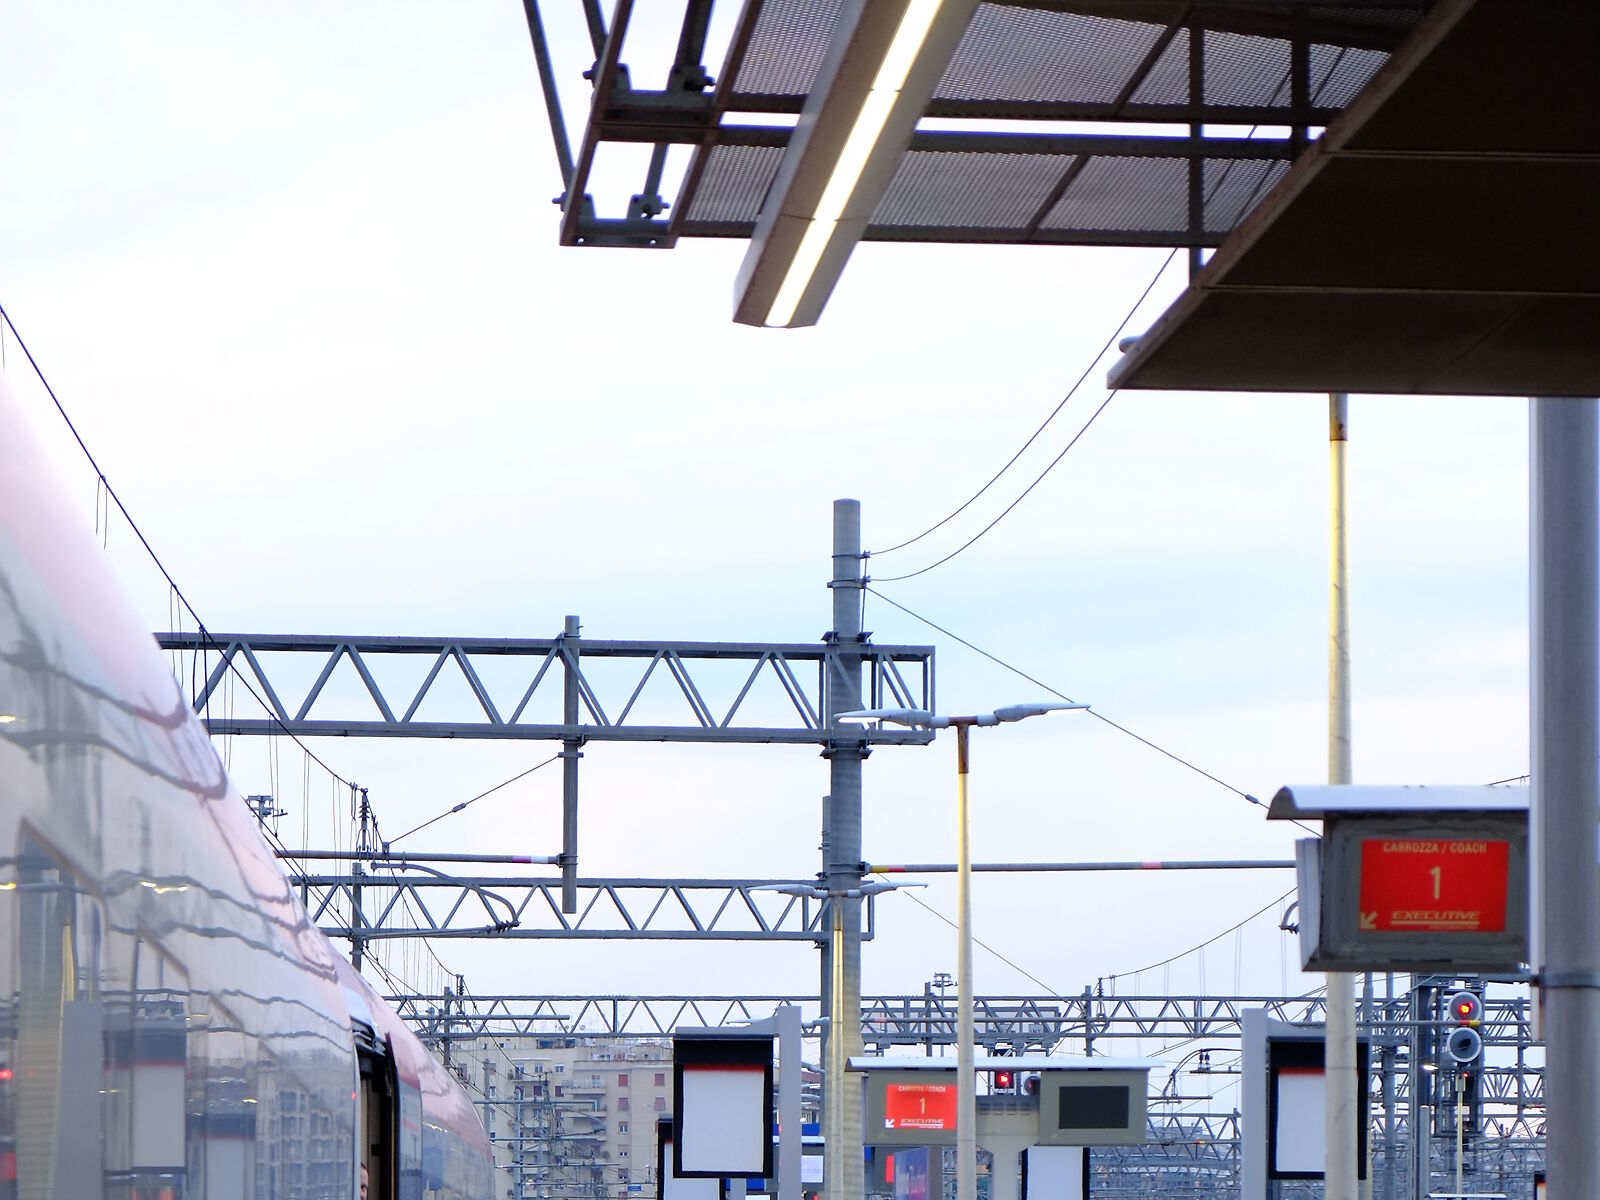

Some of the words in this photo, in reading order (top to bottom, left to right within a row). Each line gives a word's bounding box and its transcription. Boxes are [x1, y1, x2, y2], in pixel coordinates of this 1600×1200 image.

[1383, 842, 1439, 853] CARROZZA
[1451, 842, 1487, 853] COACH
[1430, 866, 1441, 900] 1
[1392, 910, 1481, 920] EXECUTIVE
[920, 1097, 926, 1114] 1
